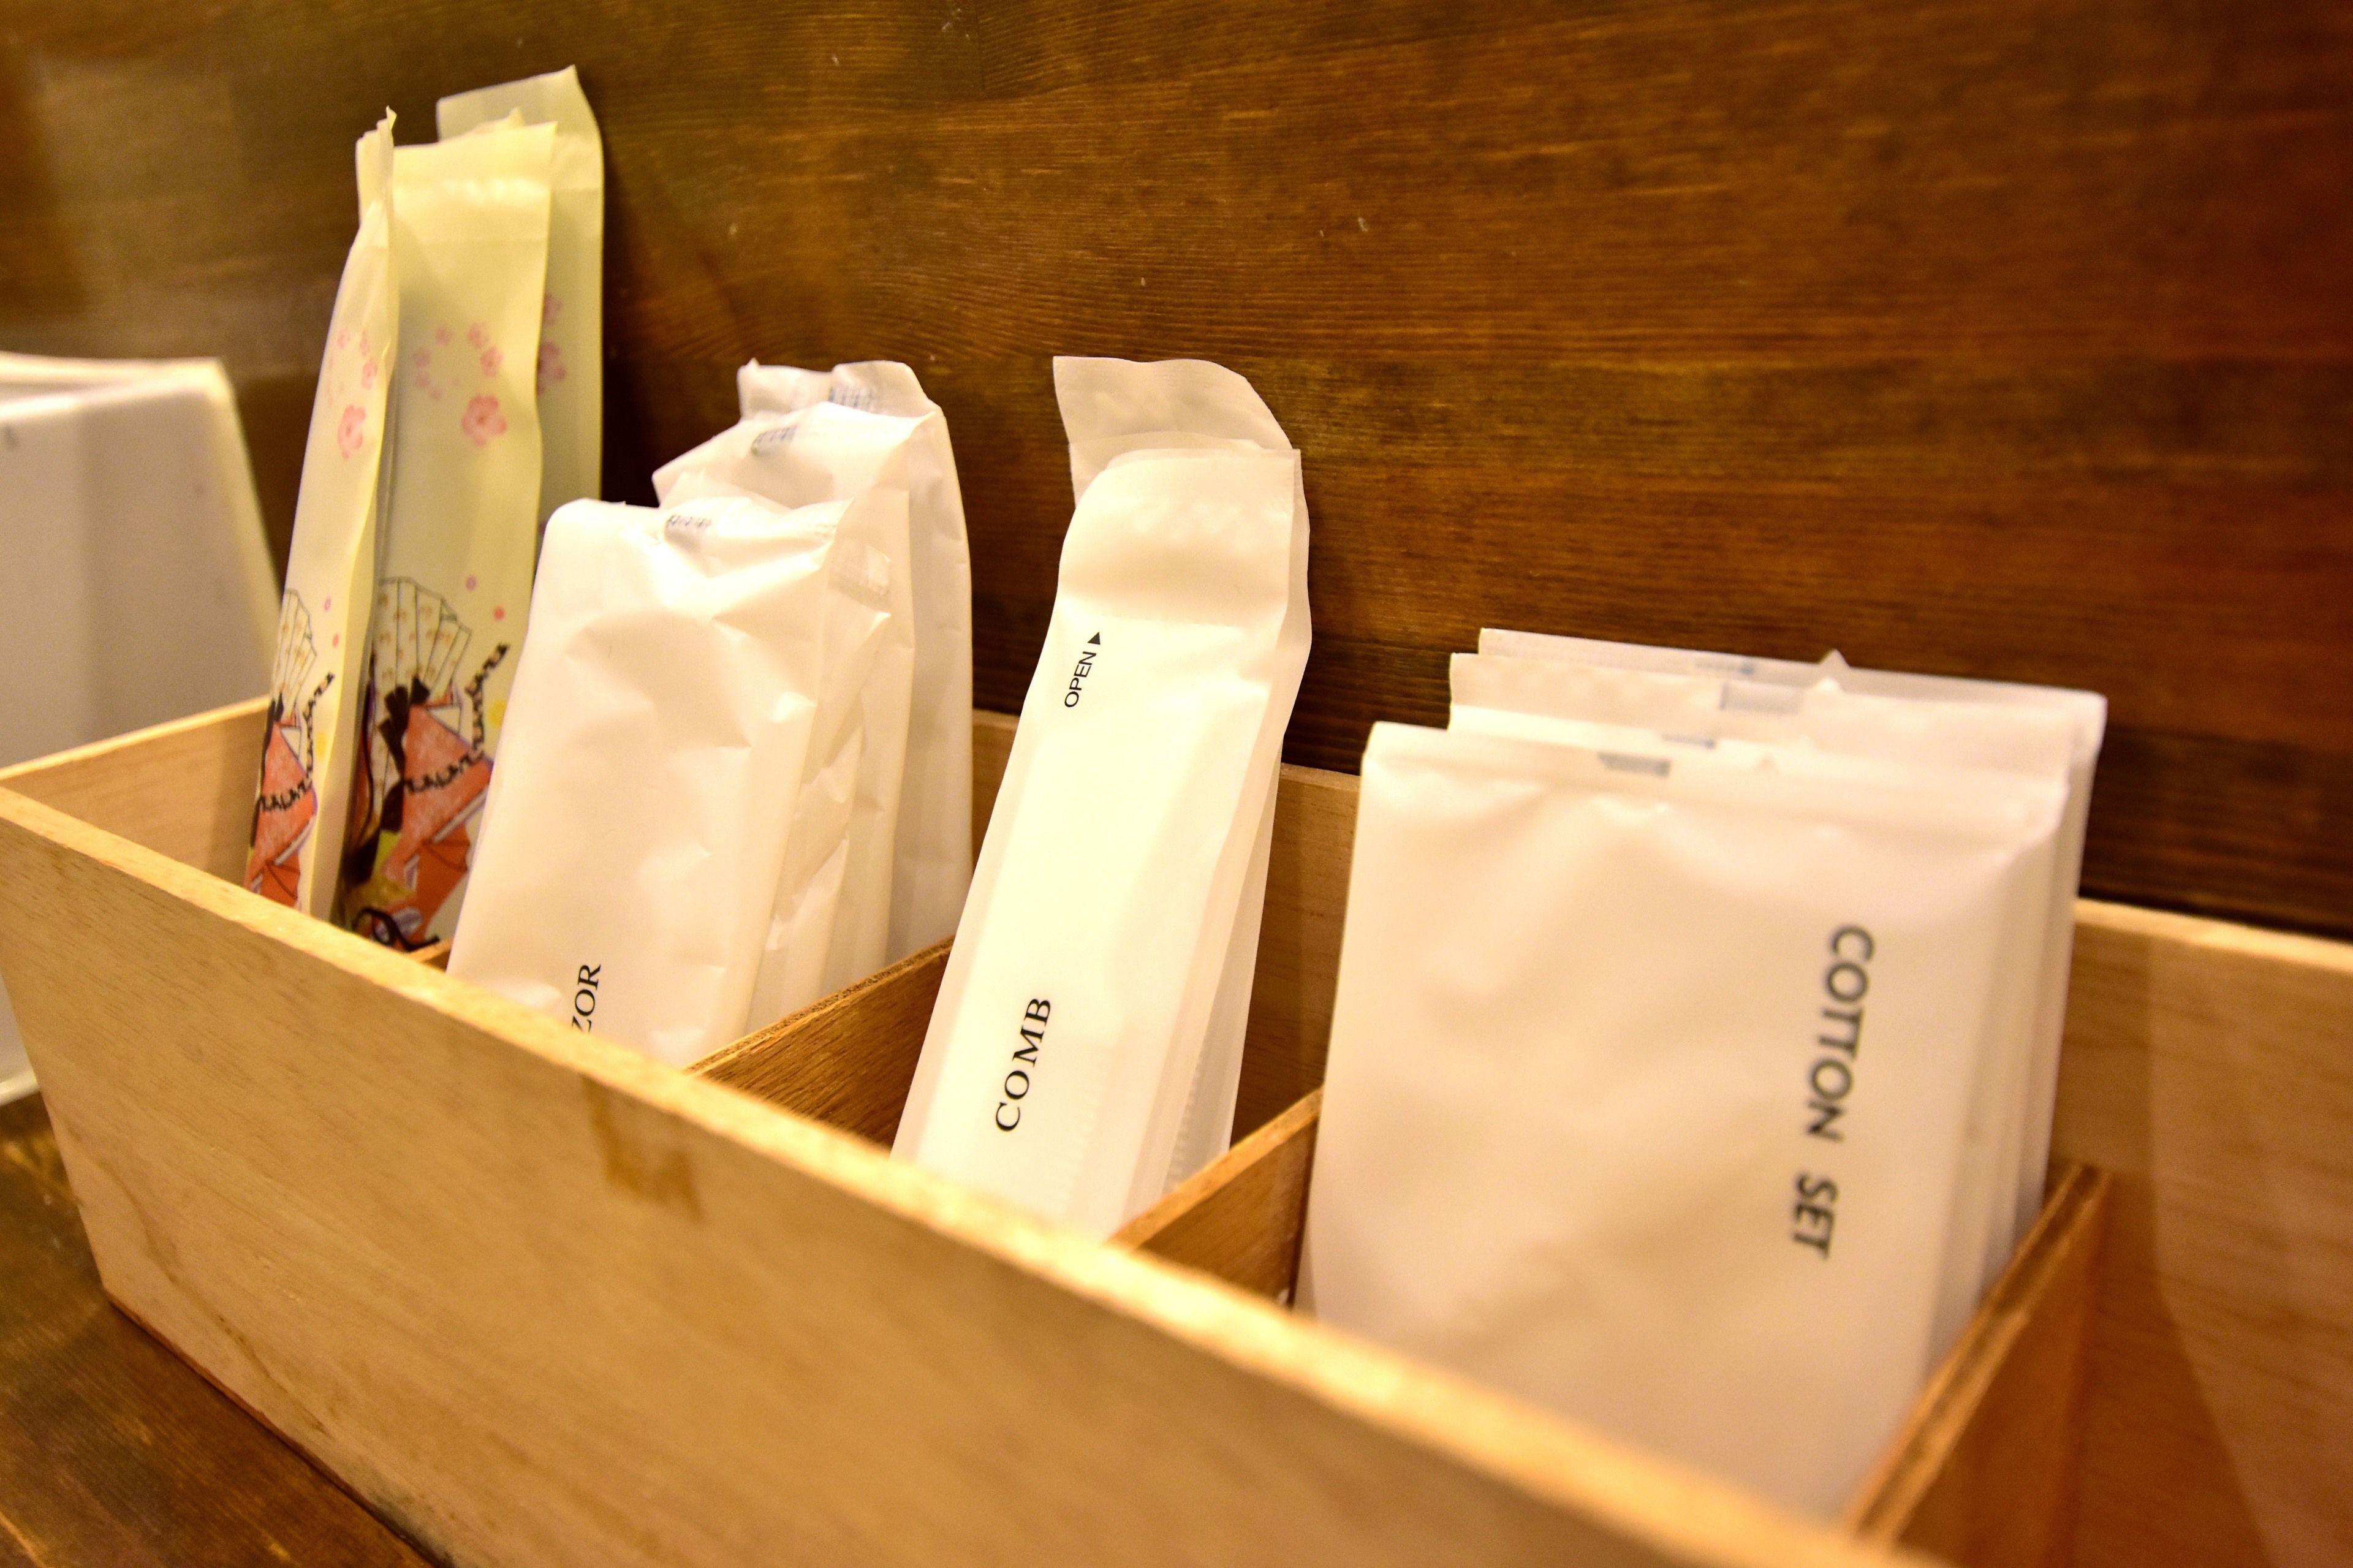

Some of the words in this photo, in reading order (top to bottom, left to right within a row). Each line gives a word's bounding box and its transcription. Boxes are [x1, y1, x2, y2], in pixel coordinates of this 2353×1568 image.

[1064, 651, 1097, 708] OPEN
[995, 998, 1051, 1132] COMB
[1804, 925, 1876, 1143] COTTON
[1789, 1171, 1840, 1260] SET
